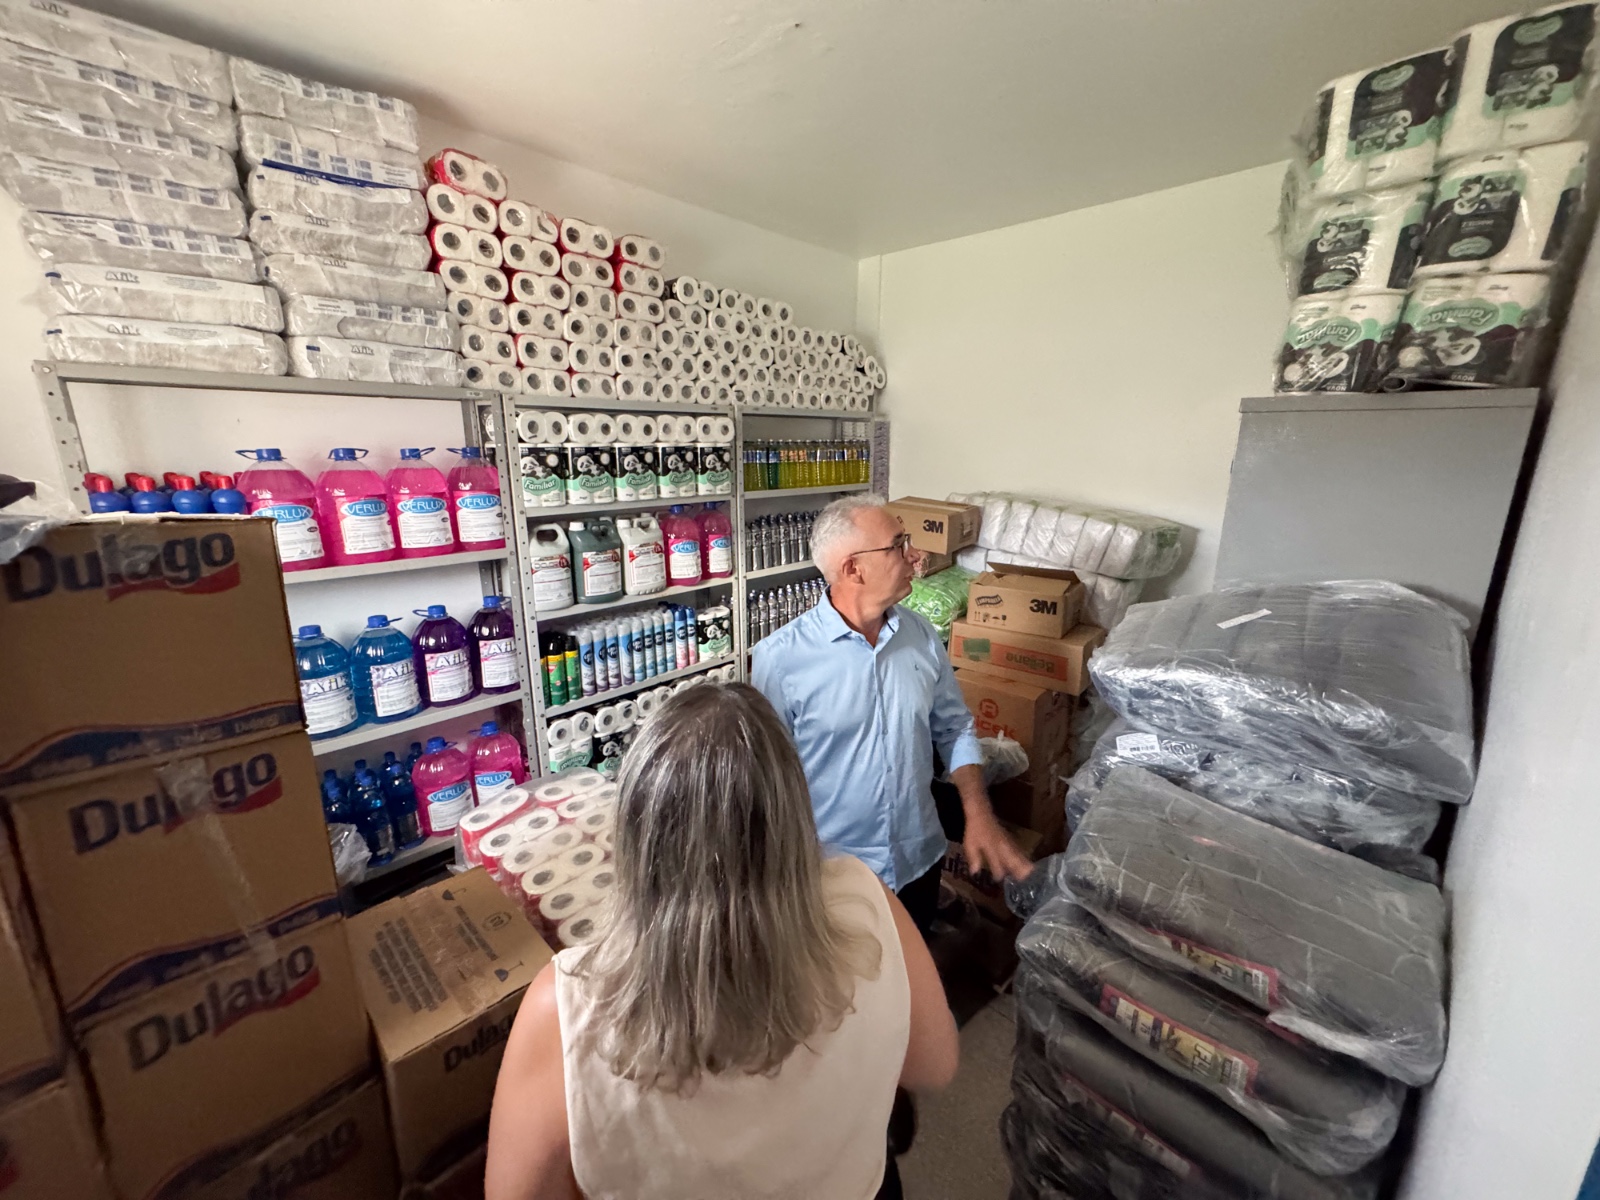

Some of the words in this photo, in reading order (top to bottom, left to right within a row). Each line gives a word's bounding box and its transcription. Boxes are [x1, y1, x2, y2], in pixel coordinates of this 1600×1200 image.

[524, 479, 556, 490] Familiar
[346, 502, 386, 514] VERLU
[401, 499, 445, 511] VERLUX
[923, 519, 943, 534] 3M
[1029, 598, 1057, 615] 3M
[125, 944, 315, 1071] Dulago
